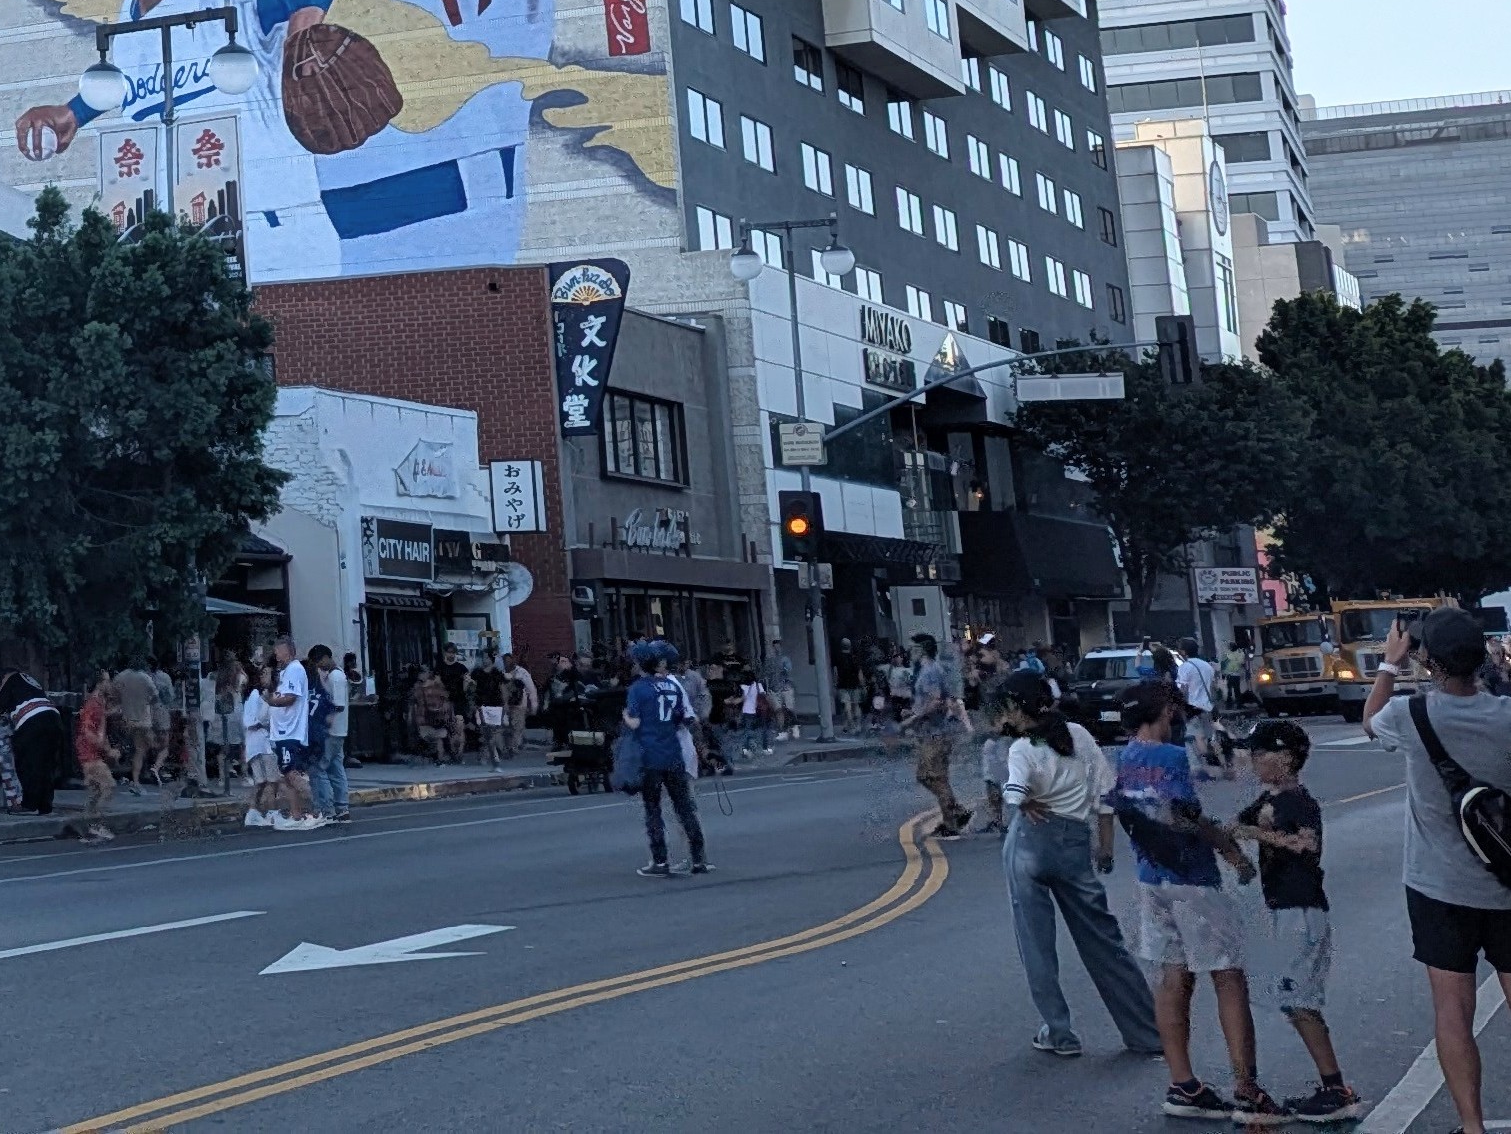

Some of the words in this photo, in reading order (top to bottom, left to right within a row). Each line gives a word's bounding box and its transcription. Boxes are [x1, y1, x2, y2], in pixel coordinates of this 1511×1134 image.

[113, 138, 145, 178] 祭
[191, 128, 225, 169] 祭
[861, 305, 912, 354] MIYAKO
[562, 314, 607, 428] 文化堂
[503, 464, 526, 530] おみやげ
[379, 537, 403, 560] CITY
[404, 540, 430, 563] HAIR
[309, 698, 320, 716] 7
[657, 694, 678, 722] 17
